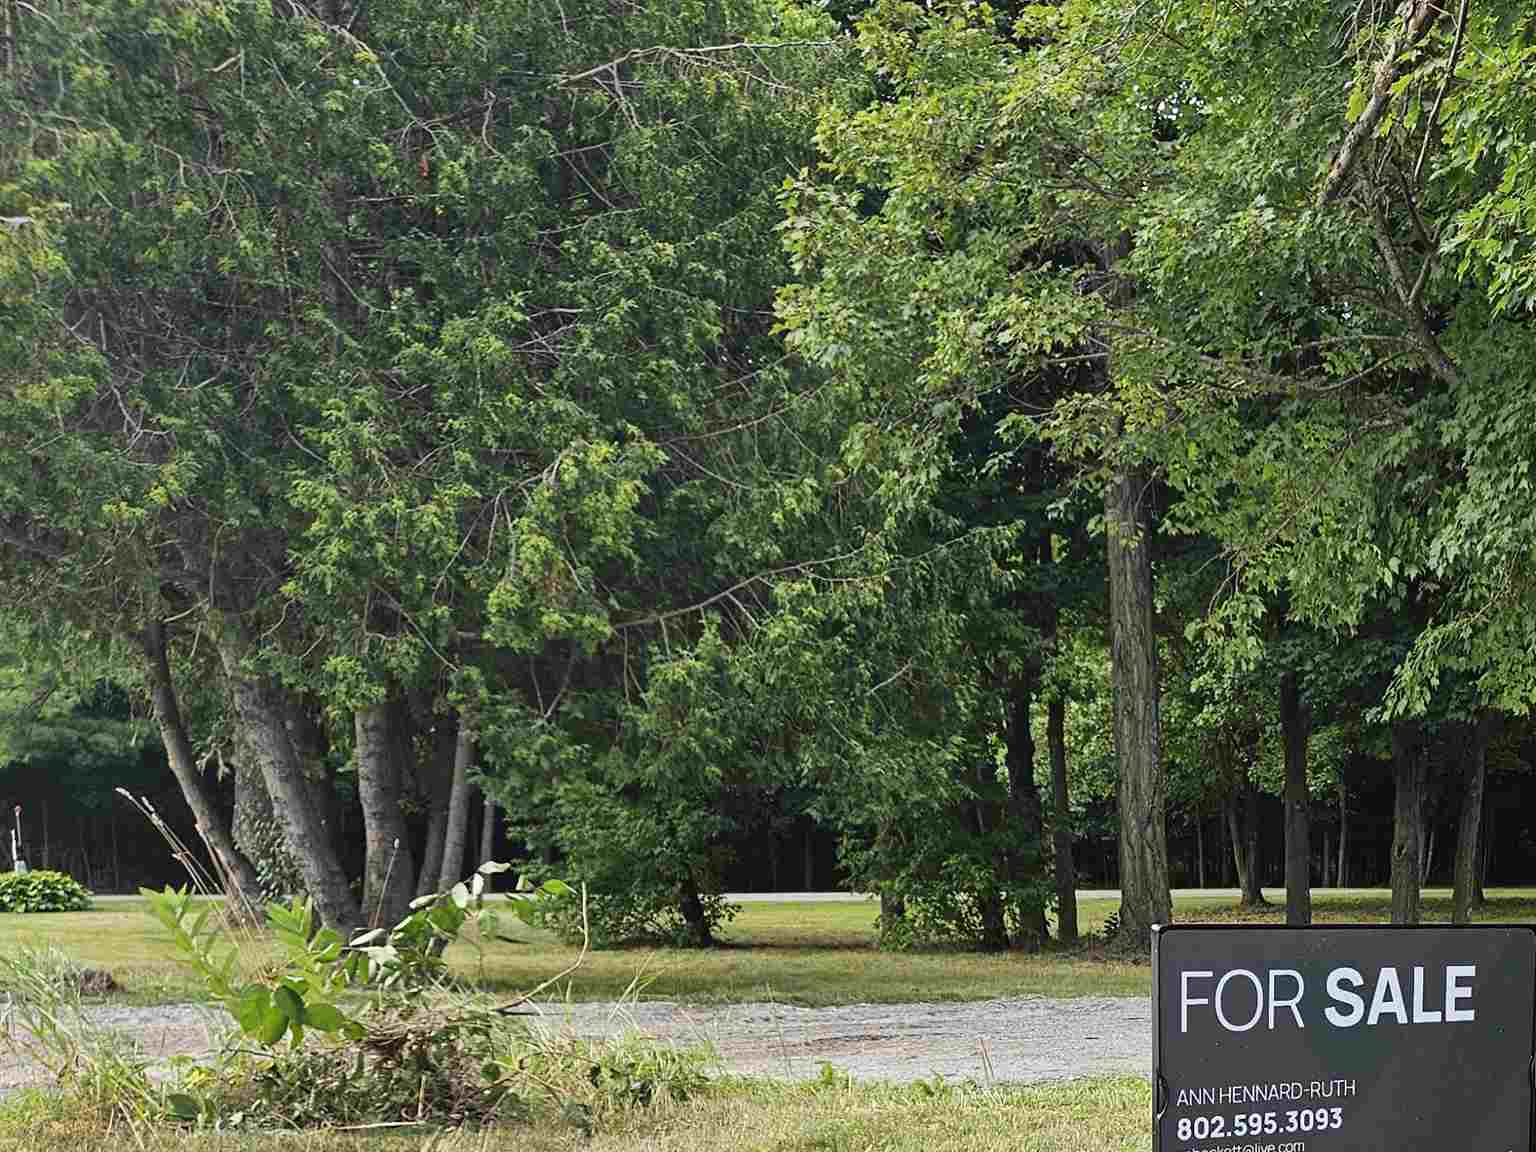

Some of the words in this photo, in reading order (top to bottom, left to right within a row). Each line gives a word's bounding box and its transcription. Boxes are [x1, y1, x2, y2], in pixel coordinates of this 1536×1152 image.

[1179, 968, 1305, 1033] FOR
[1324, 965, 1477, 1028] SALE
[1176, 1087, 1215, 1107] ANN
[1219, 1079, 1356, 1104] HENNARD-RUTH
[1176, 1107, 1344, 1141] 802.595.3093
